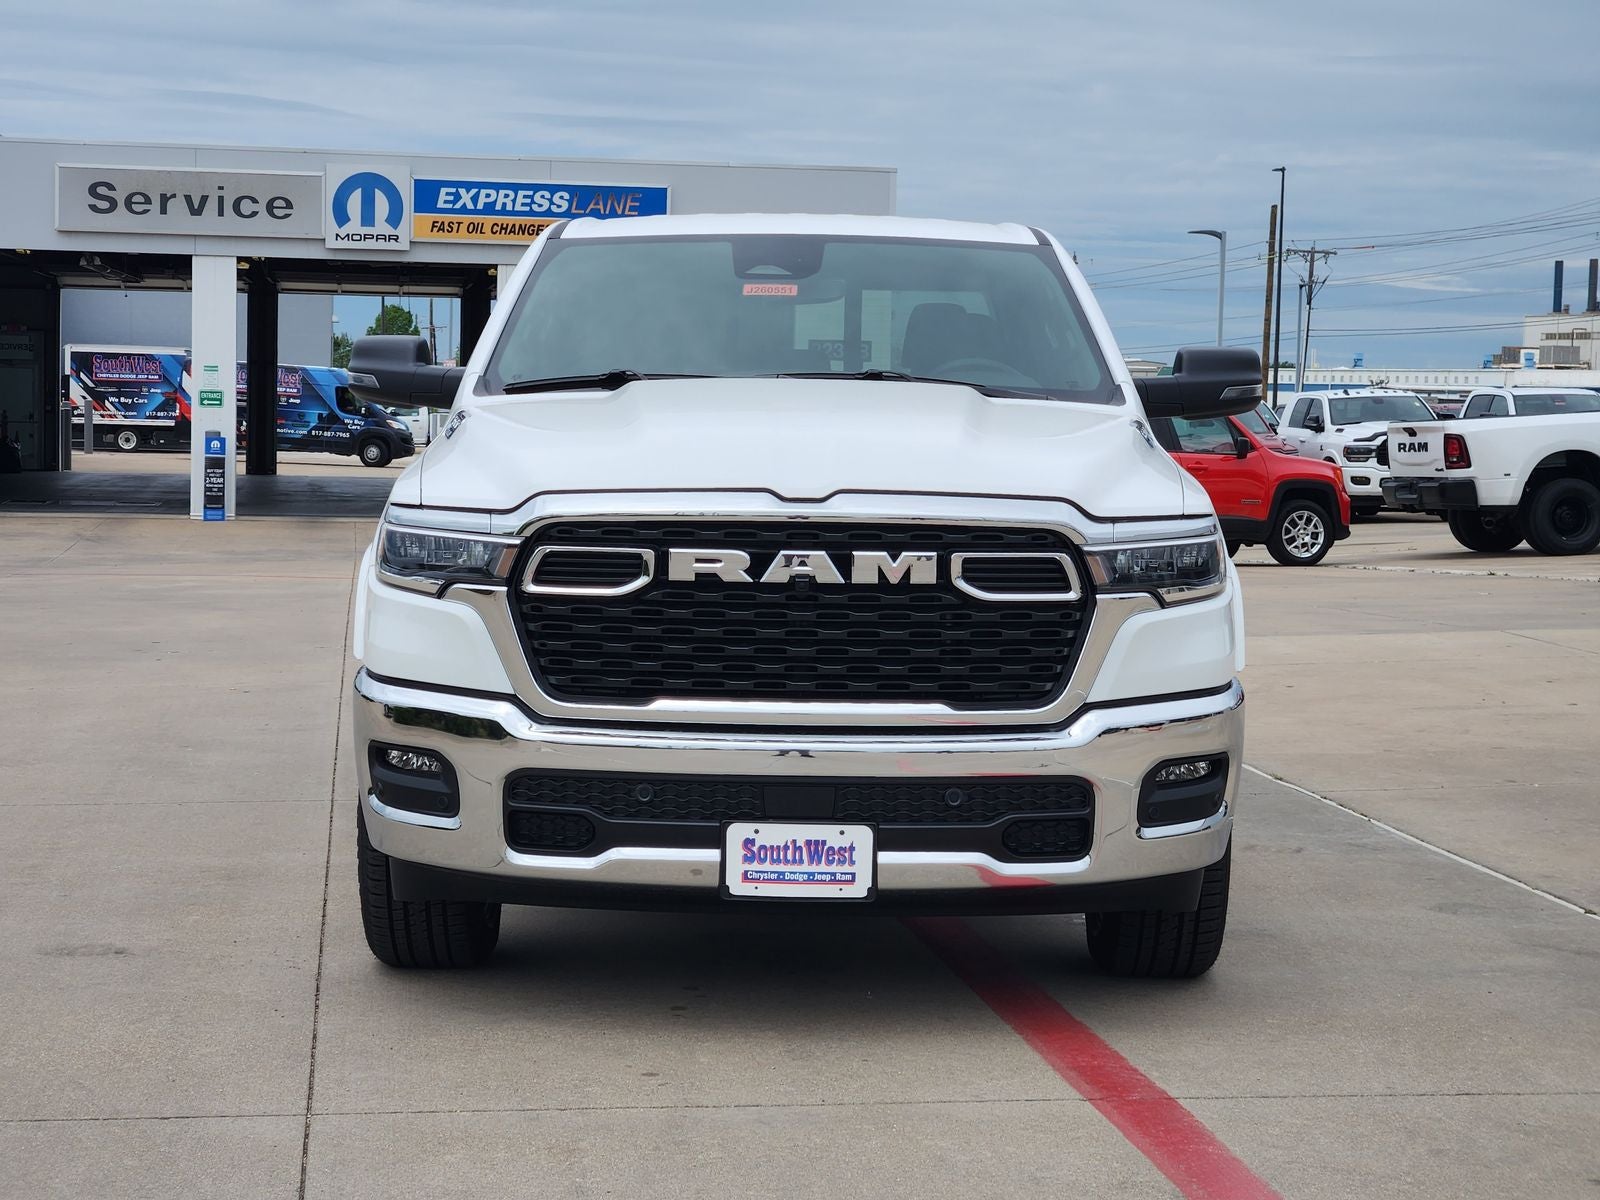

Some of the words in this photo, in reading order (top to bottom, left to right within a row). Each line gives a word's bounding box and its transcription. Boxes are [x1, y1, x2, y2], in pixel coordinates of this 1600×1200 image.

[87, 181, 294, 220] Service
[430, 220, 464, 234] FAST
[466, 221, 486, 235] OIL
[490, 222, 549, 236] CHANGE
[335, 233, 400, 243] MOPAR
[746, 286, 793, 294] J260551
[93, 355, 161, 373] SouthWest
[311, 430, 350, 438] 817-887-7965
[1398, 442, 1428, 452] RAM
[668, 548, 938, 585] RAM
[742, 837, 856, 867] SouthWest
[747, 871, 778, 881] Chrysler
[785, 872, 808, 882] Dodge
[813, 872, 831, 882] Jeep
[836, 873, 852, 881] Ram
